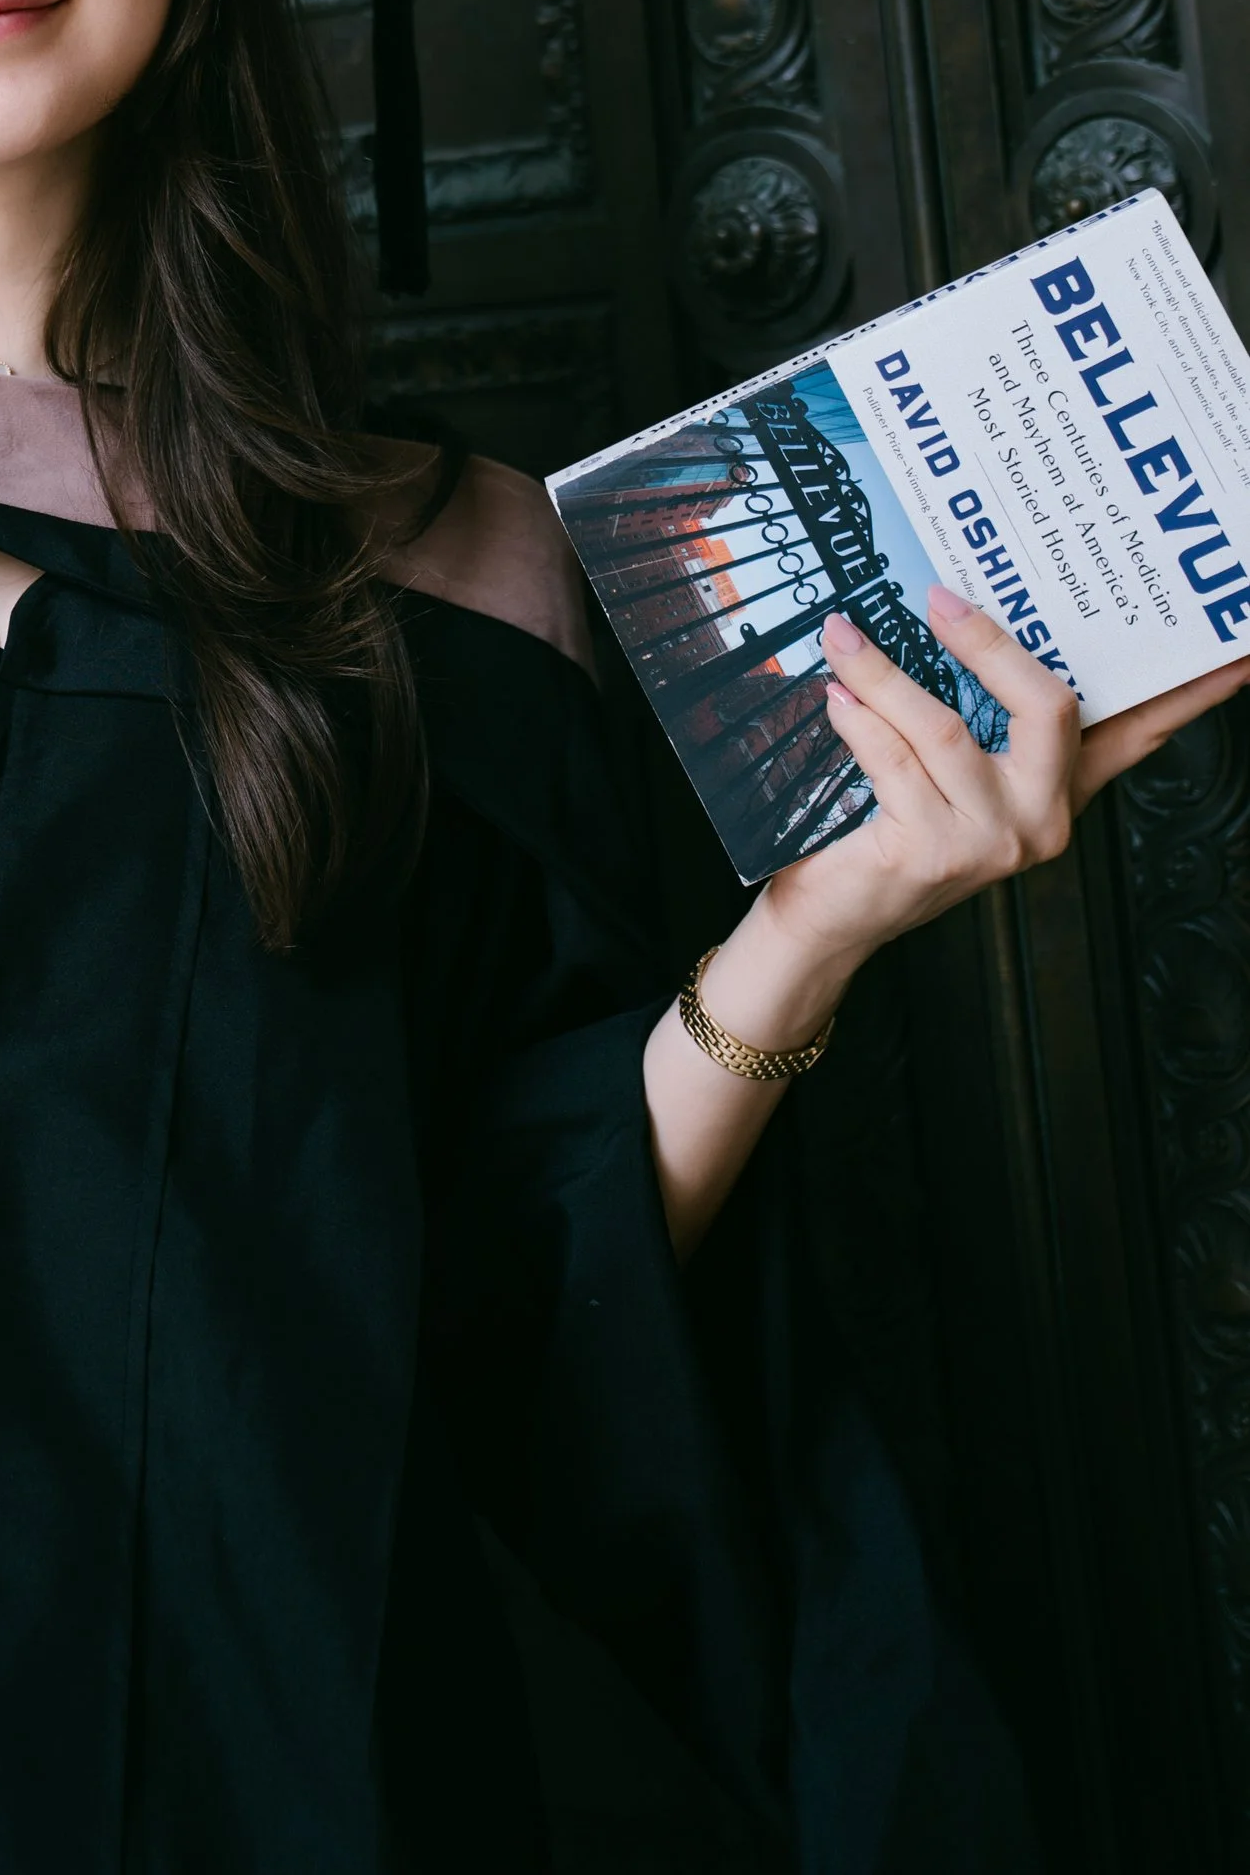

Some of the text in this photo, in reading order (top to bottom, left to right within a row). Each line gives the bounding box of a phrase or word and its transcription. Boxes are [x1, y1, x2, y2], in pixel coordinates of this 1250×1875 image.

[893, 190, 1139, 316] BELLEVUE
[1142, 248, 1180, 311] convincingly
[1178, 316, 1219, 389] demonstrates,
[1218, 390, 1227, 401] is
[1225, 403, 1238, 421] the
[1175, 269, 1192, 288] and
[1188, 291, 1220, 345] deliciously
[792, 319, 877, 366] DAVID
[875, 350, 962, 477] DAVID
[1126, 258, 1142, 280] New
[1140, 283, 1157, 309] York
[1154, 311, 1170, 336] City,
[1168, 339, 1185, 358] and
[1181, 362, 1193, 372] of
[1188, 377, 1214, 419] America
[755, 399, 874, 584] BELLEVUE
[863, 387, 888, 428] Pulitzer
[928, 516, 951, 550] Author
[949, 555, 961, 565] of
[956, 569, 977, 605] Polio:
[968, 387, 1100, 619] Most Storied Hospital
[989, 354, 1021, 392] and
[1012, 397, 1065, 486] Mayhem
[1062, 494, 1084, 514] at
[1011, 320, 1177, 627] Three Centuries of Medicine
[1030, 258, 1250, 643] BELLEVUE
